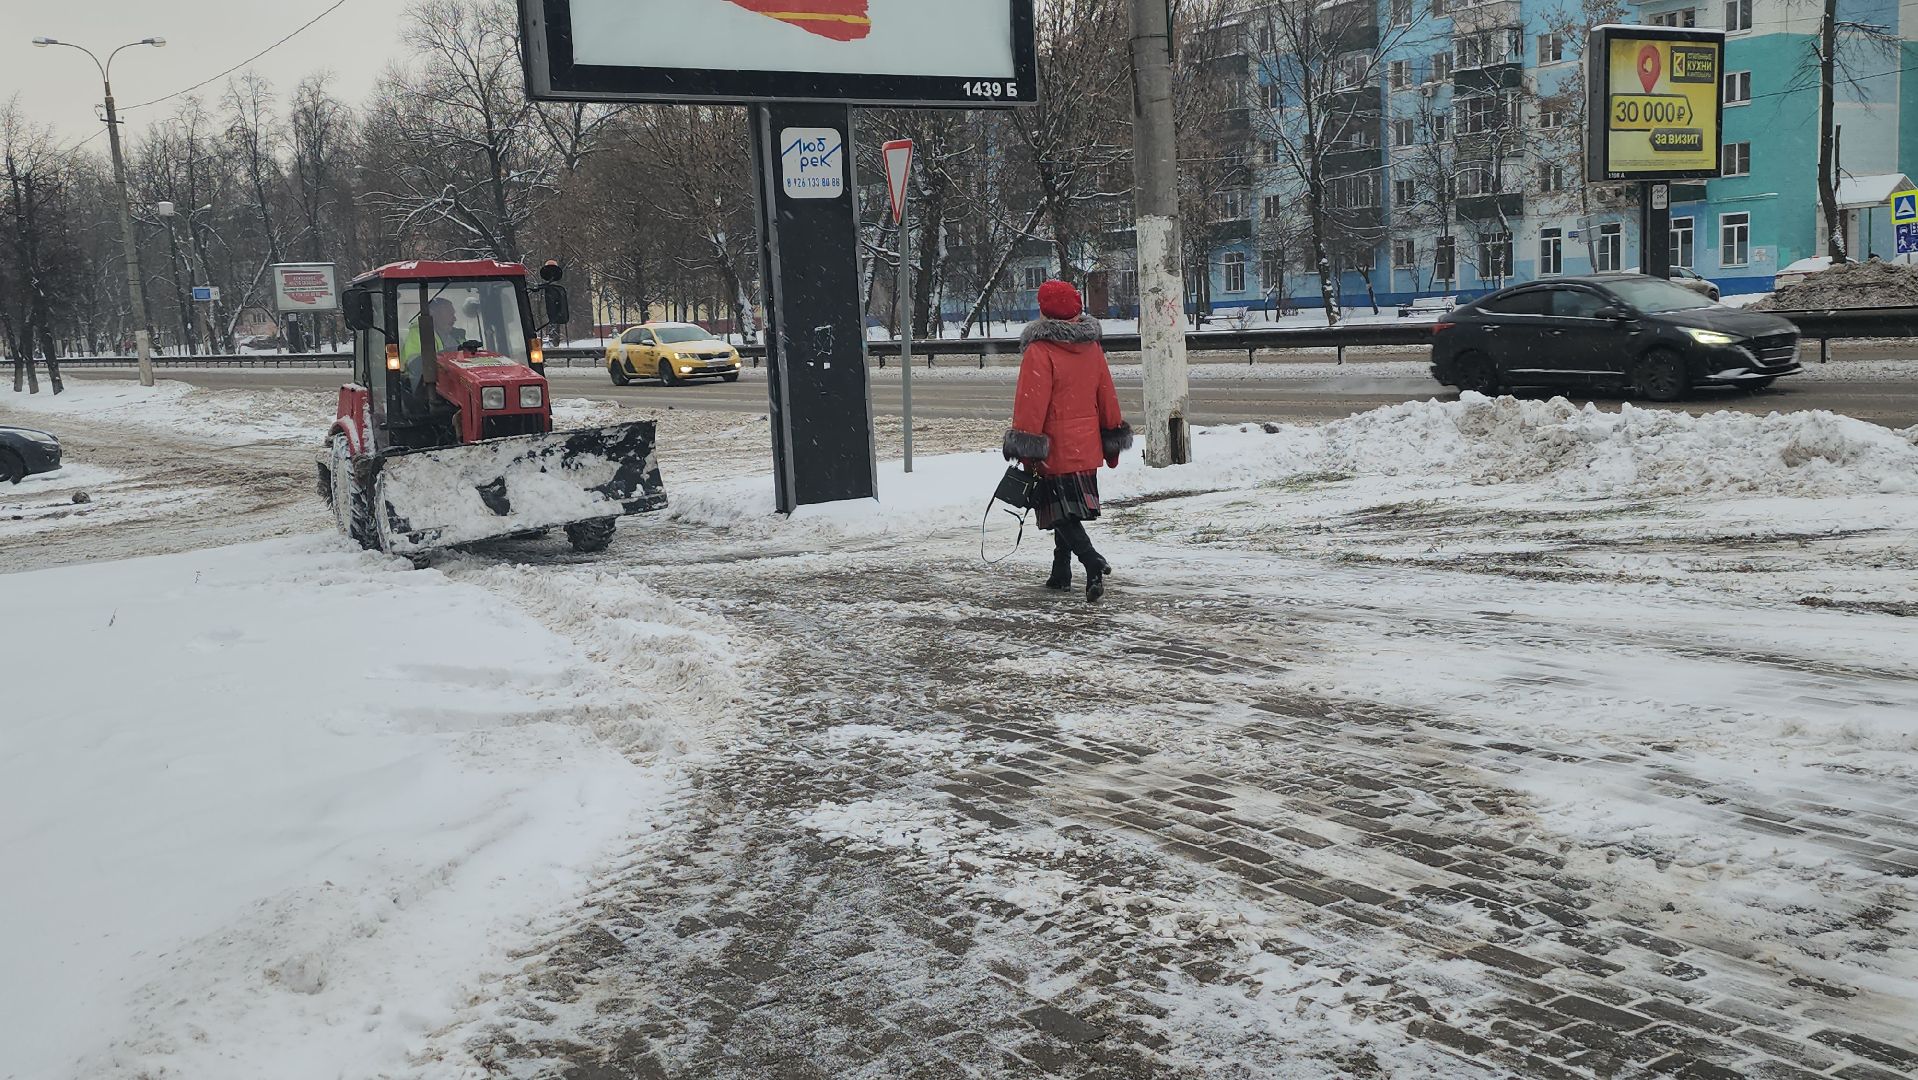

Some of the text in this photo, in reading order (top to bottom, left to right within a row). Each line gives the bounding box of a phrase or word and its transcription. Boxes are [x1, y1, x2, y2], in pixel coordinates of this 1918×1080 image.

[1687, 60, 1712, 71] КУХНИ
[963, 81, 1018, 97] 1439 Б
[1615, 101, 1639, 122] 30
[781, 137, 827, 156] Люб
[787, 178, 791, 187] 8
[808, 178, 820, 187] 133
